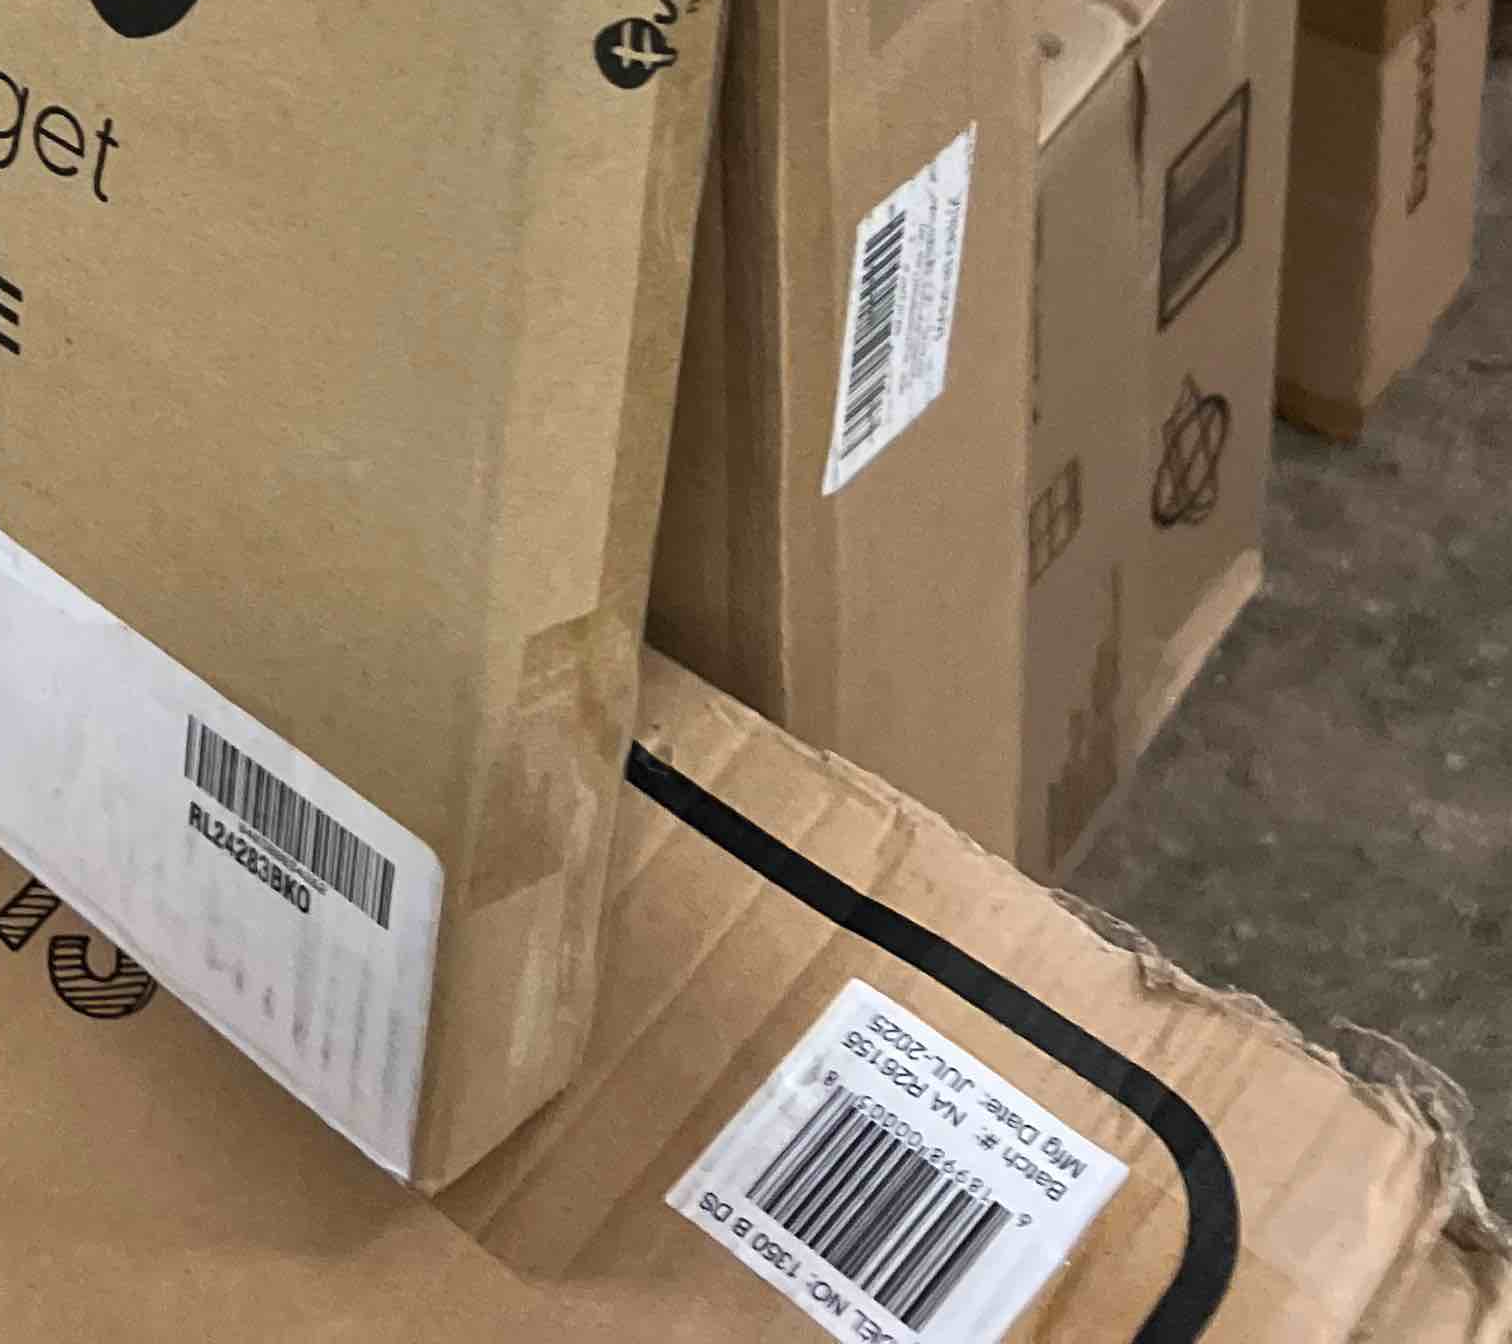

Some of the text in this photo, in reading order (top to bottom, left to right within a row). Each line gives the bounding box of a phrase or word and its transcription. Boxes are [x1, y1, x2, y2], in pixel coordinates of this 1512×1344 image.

[862, 1010, 1092, 1181] Mfg Date: JUL-2025
[924, 1090, 970, 1129] NA
[994, 1143, 1072, 1204] Batch
